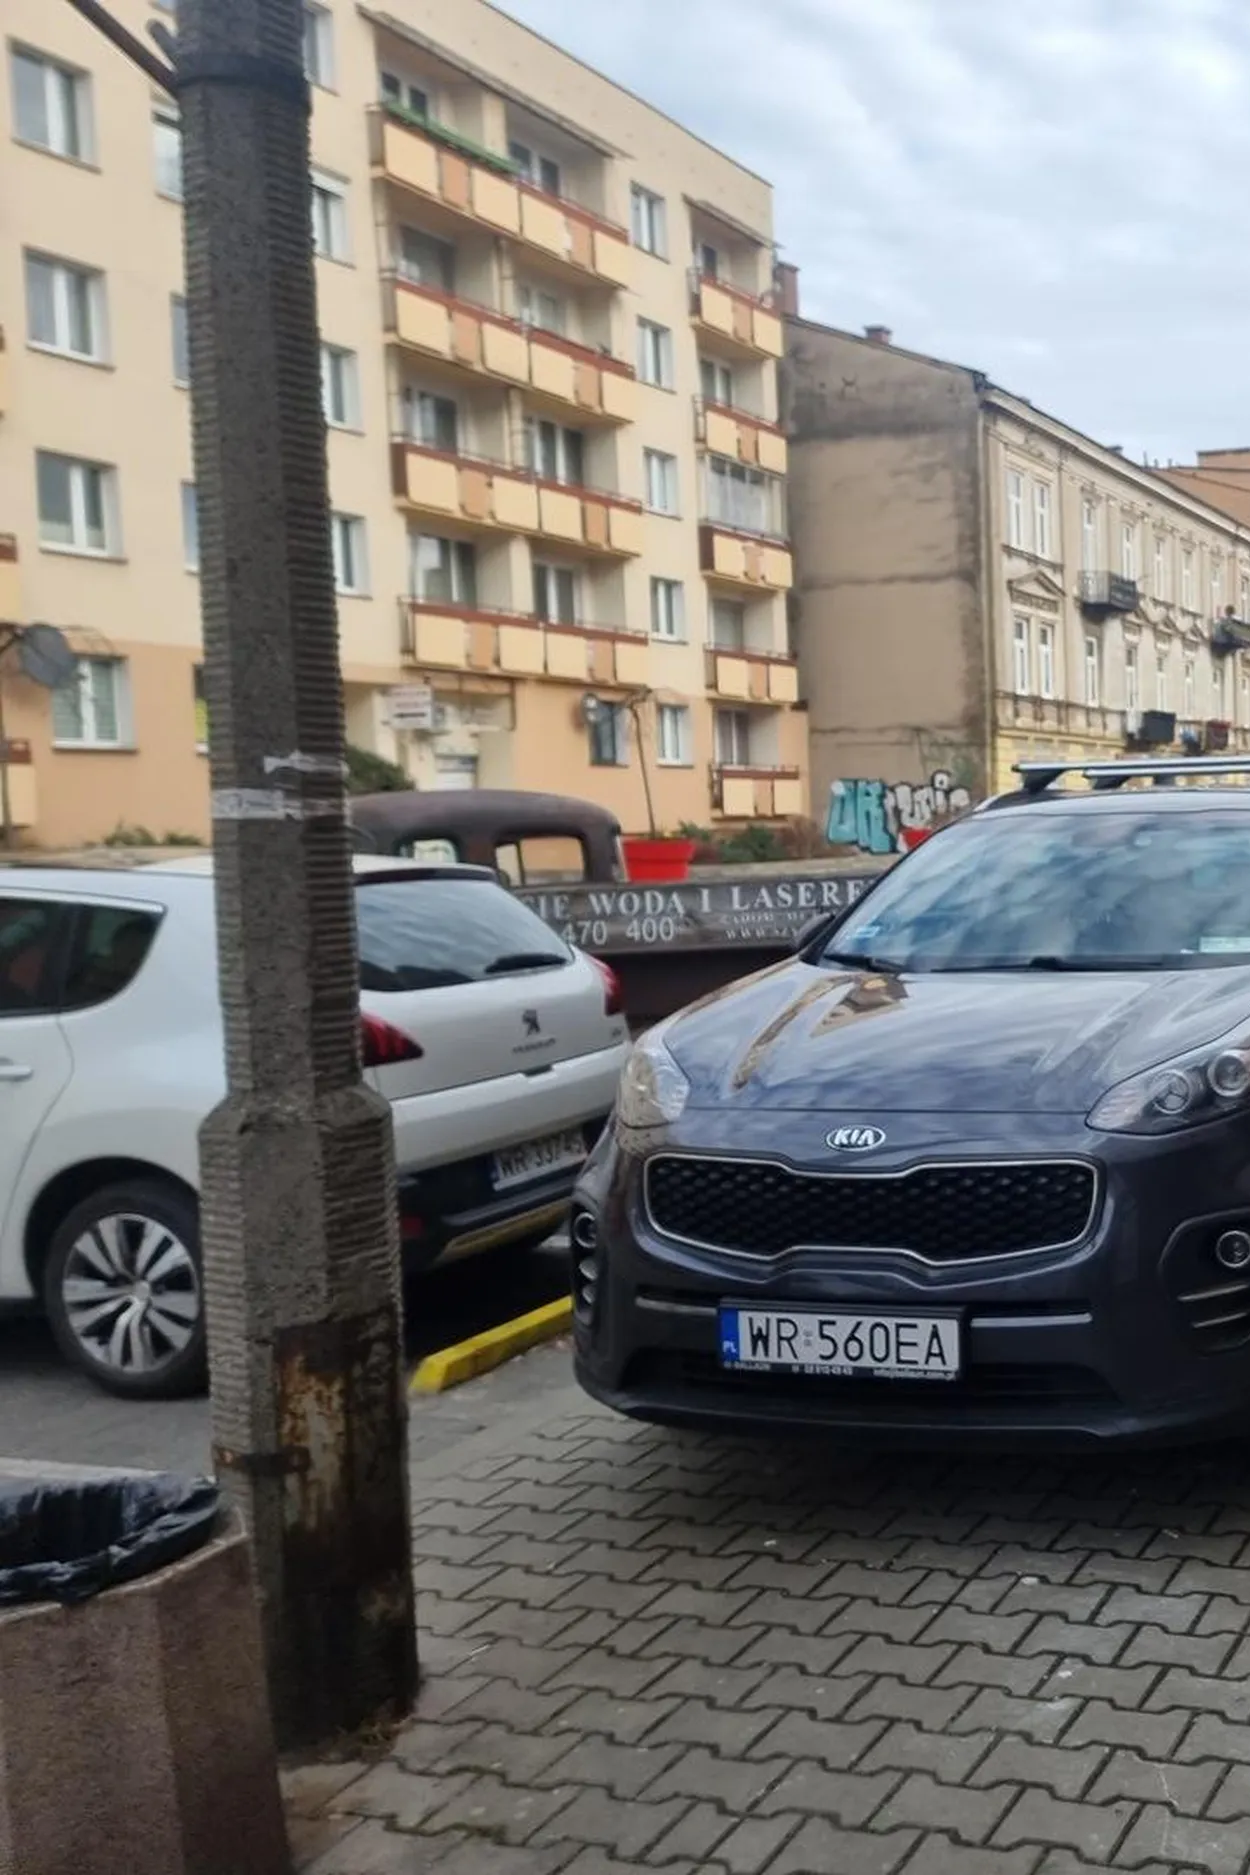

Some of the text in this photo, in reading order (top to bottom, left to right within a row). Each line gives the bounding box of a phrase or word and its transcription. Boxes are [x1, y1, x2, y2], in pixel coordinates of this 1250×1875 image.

[701, 888, 711, 912] I
[731, 879, 874, 911] LASERE
[625, 916, 675, 942] 400
[834, 1129, 875, 1145] KIA
[722, 1341, 737, 1352] PL
[748, 1316, 947, 1367] WR 560EA
